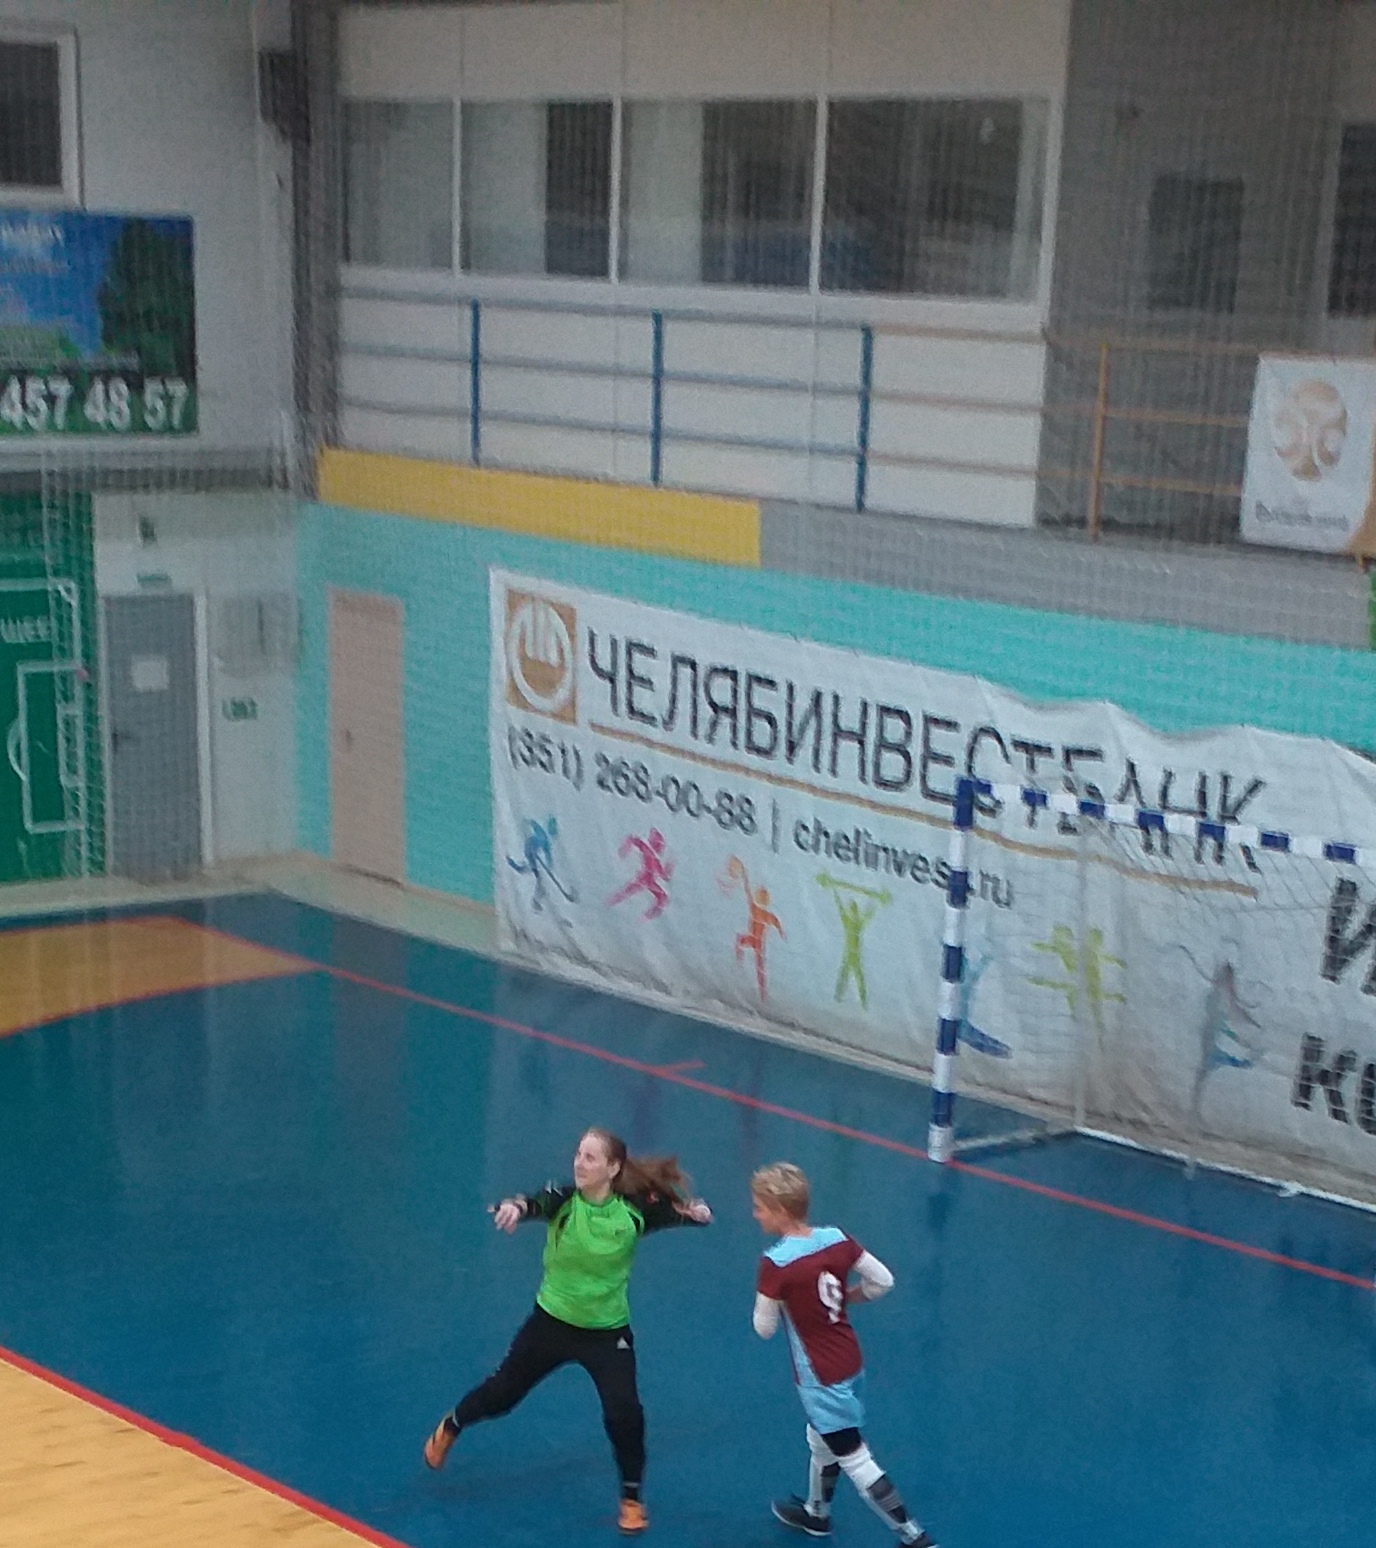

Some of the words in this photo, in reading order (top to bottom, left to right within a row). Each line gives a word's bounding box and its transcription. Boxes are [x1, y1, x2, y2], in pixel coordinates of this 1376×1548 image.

[143, 375, 188, 431] 57
[507, 723, 585, 792] (351)
[594, 751, 759, 837] 268-00-88
[586, 626, 1267, 875] ЧЕЛЯБИНВЕСТБАНК
